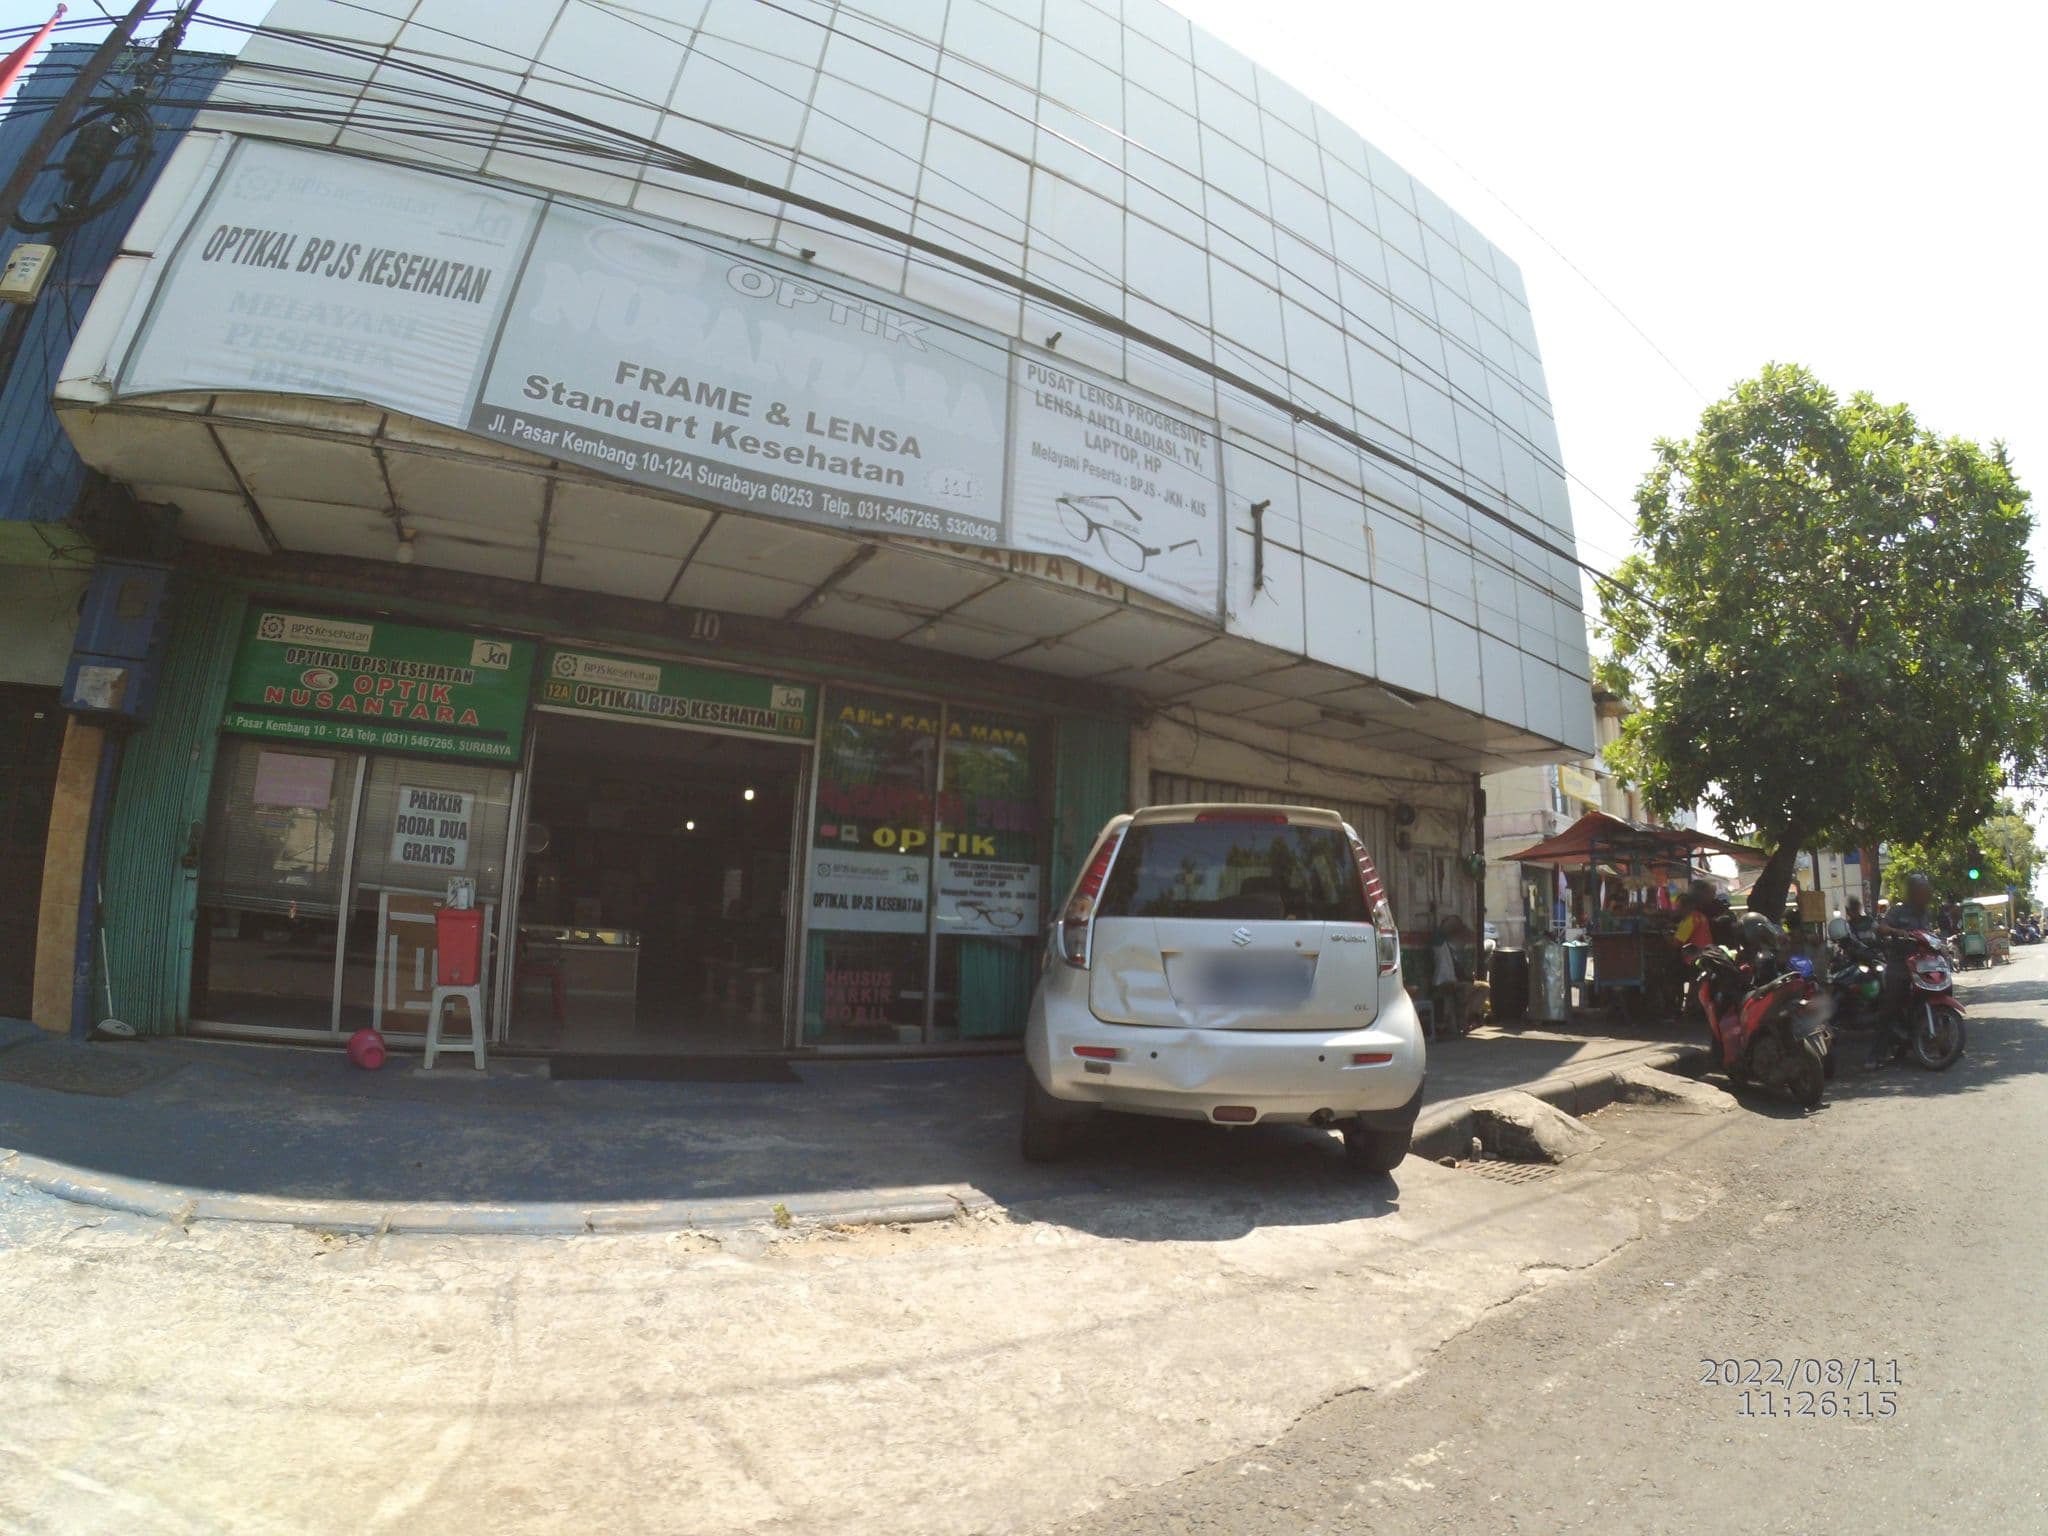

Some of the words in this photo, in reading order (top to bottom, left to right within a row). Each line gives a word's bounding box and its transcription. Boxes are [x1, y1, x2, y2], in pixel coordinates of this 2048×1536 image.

[201, 224, 298, 271] OPTIKAL
[296, 236, 361, 281] BPJS
[357, 246, 491, 304] KESEHATAN
[726, 263, 930, 354] OPTIK
[615, 360, 752, 418] FRAME
[765, 402, 791, 428] &
[806, 410, 921, 459] LENSA
[1028, 363, 1075, 395] PUSAT
[1079, 379, 1124, 416] LENSA
[1127, 403, 1208, 448] PROGRESIVE
[1035, 389, 1083, 422] LENSA
[1088, 410, 1121, 436] ANTI
[1124, 422, 1182, 461] RADIASI,
[522, 374, 698, 440] Standart
[711, 421, 906, 488] Kesehatan
[1084, 430, 1141, 470] LAPTOP,
[1144, 451, 1163, 474] HP
[488, 413, 506, 435] Jl.
[511, 418, 559, 448] Pasar
[562, 429, 637, 472] Kembang
[641, 450, 693, 482] 10-12A
[697, 463, 767, 504] Surabaya
[771, 482, 813, 509] 60253
[821, 492, 853, 519] Telp.
[946, 516, 998, 543] 5320428
[1031, 441, 1081, 473] Melayani
[1083, 459, 1122, 485] Peserta
[1129, 474, 1156, 498] BPJS
[1163, 488, 1183, 511] JKN
[1190, 498, 1207, 518] KIS
[690, 612, 720, 640] 10
[286, 648, 348, 670] OPTIKAL
[350, 653, 387, 674] BPJS
[390, 660, 474, 684] KESEHATAN
[264, 685, 479, 726] NUSANTARA
[354, 674, 452, 704] OPTIK
[575, 684, 648, 712] OPTIKAL
[649, 693, 688, 717] BPJS
[690, 700, 777, 729] KESEHATAN
[236, 716, 264, 729] Pasar
[265, 719, 310, 737] Kembang
[313, 724, 326, 736] 10
[335, 726, 354, 739] 12A
[382, 732, 408, 746] (031)
[459, 740, 512, 756] SURABAYA
[409, 789, 463, 814] PARKIR
[396, 814, 435, 837] RODA
[438, 819, 467, 840] DUA
[873, 826, 996, 856] OPTIK
[402, 841, 455, 866] GRATIS
[813, 892, 849, 910] OPTIKAL
[852, 894, 874, 911] BPJS
